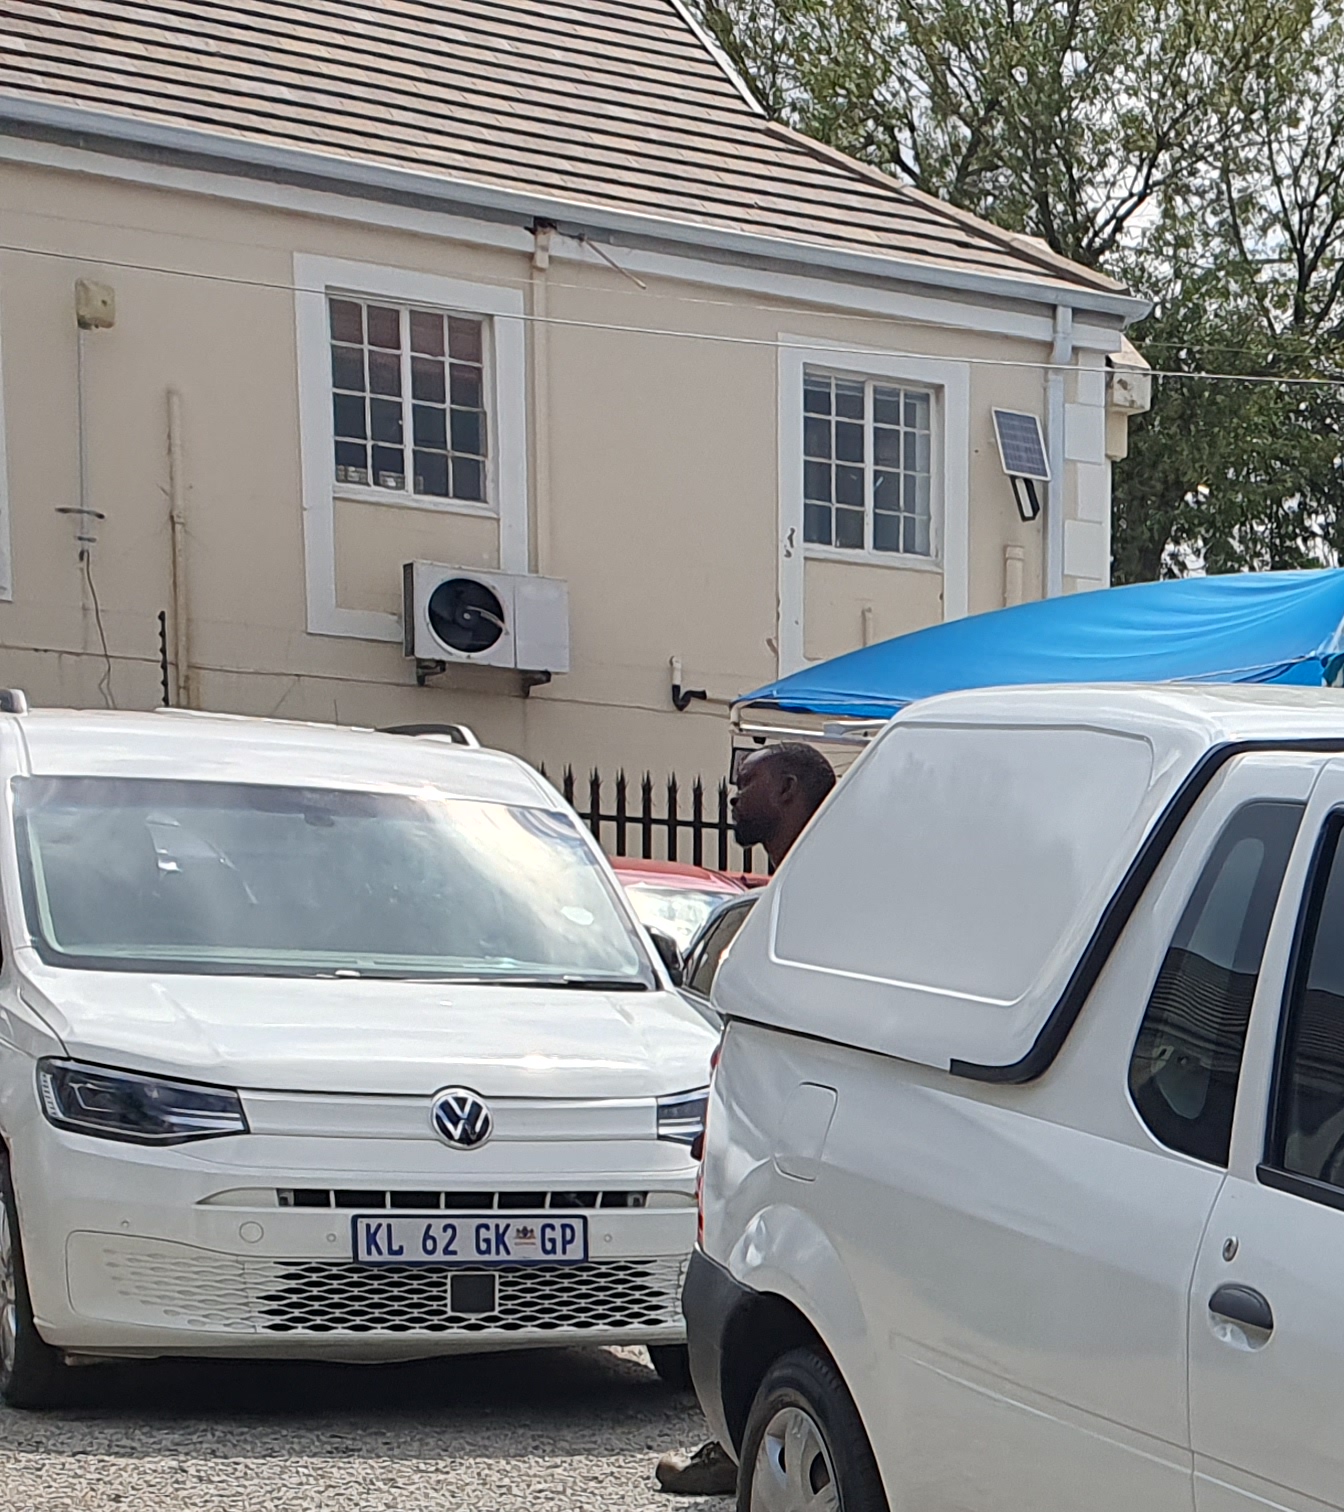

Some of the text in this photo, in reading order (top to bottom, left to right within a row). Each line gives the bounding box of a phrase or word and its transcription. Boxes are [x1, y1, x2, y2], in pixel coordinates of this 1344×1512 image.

[365, 1222, 576, 1256] KL 62 GK GP
